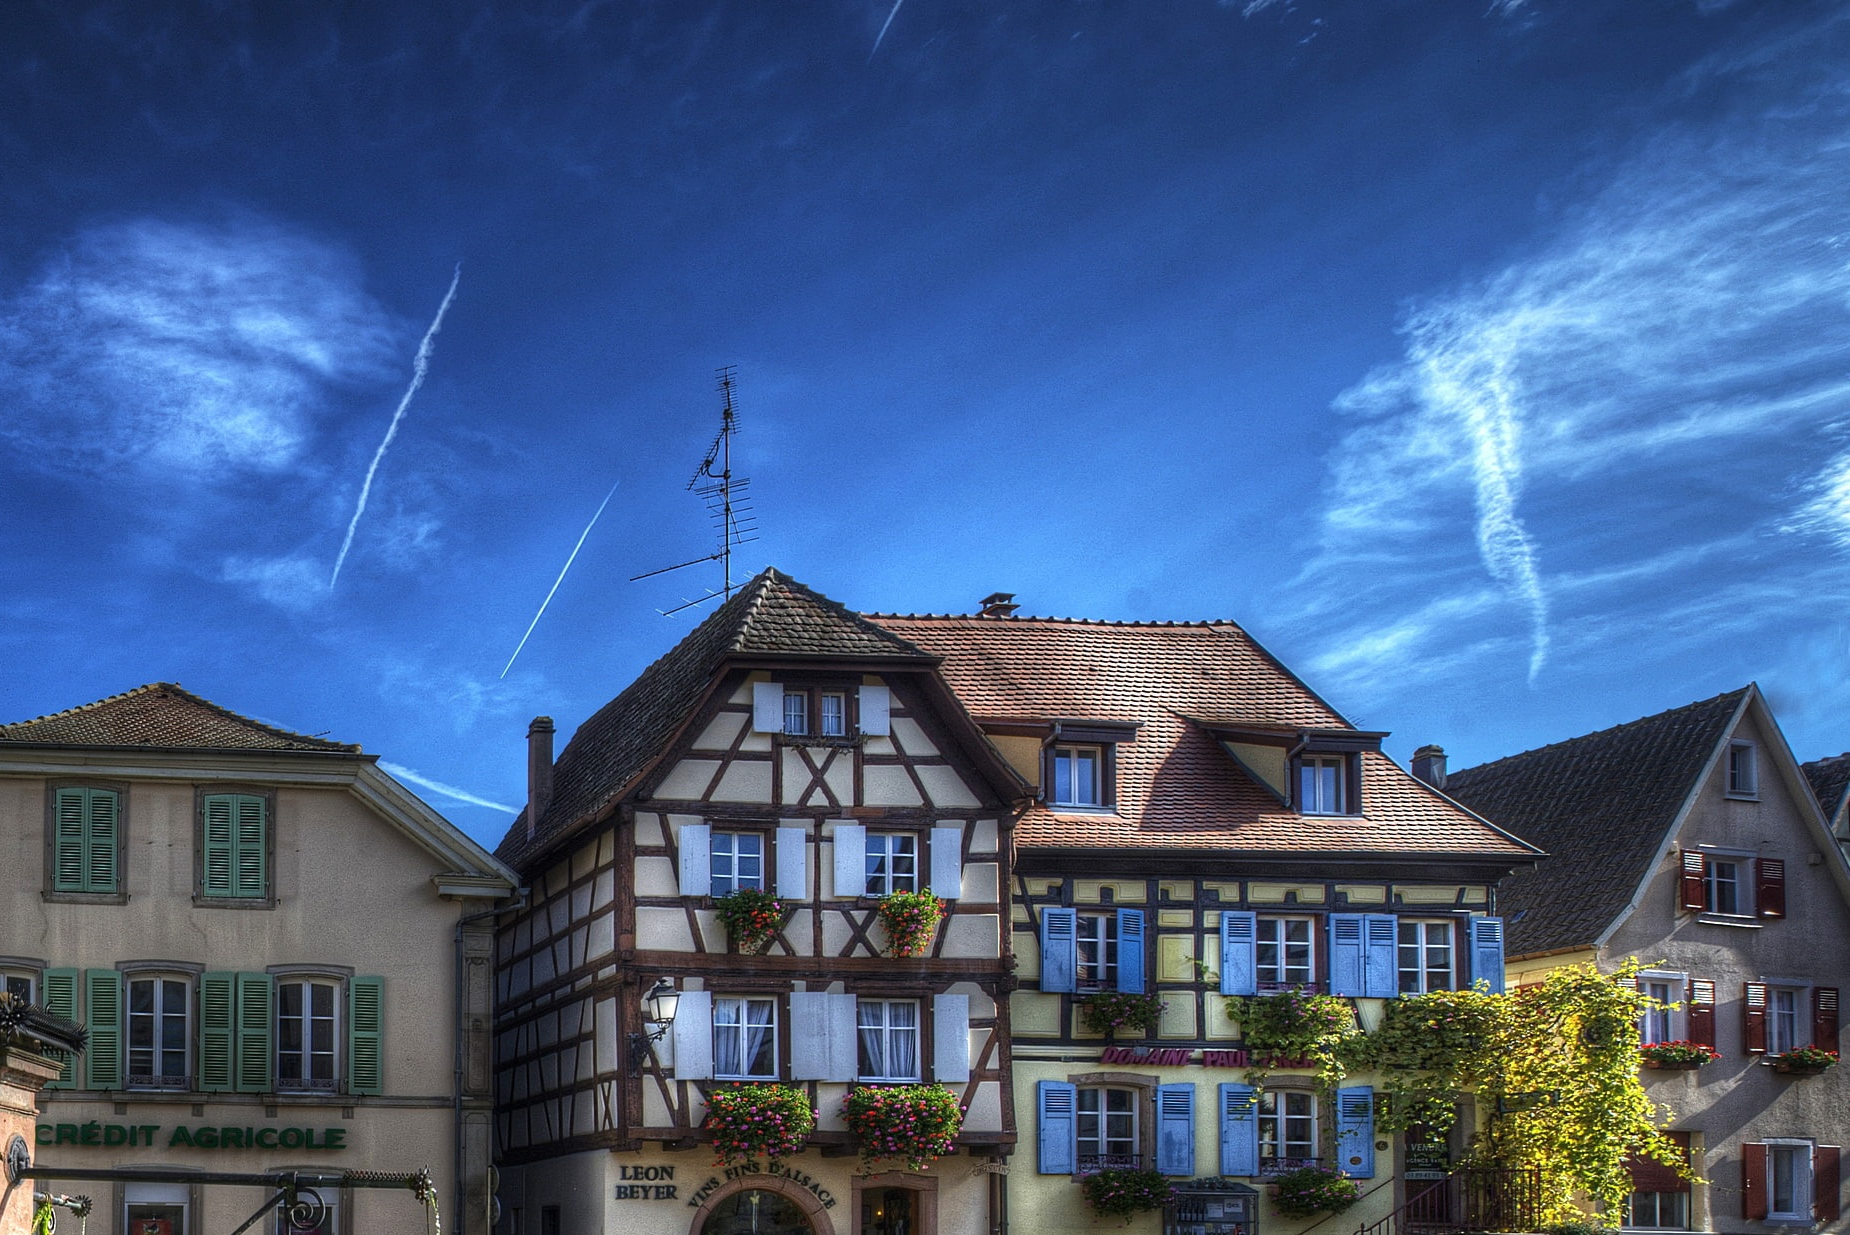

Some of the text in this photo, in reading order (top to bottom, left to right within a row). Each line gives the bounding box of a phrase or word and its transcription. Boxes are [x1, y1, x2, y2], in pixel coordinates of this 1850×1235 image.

[1101, 1045, 1194, 1066] DOMAINE
[1203, 1050, 1251, 1067] PAUL
[35, 1119, 347, 1149] CRÉDIT AGRICOLE
[620, 1165, 676, 1181] LEON
[615, 1184, 679, 1200] BEYER
[688, 1161, 837, 1210] VINS FINS D'ALSACE
